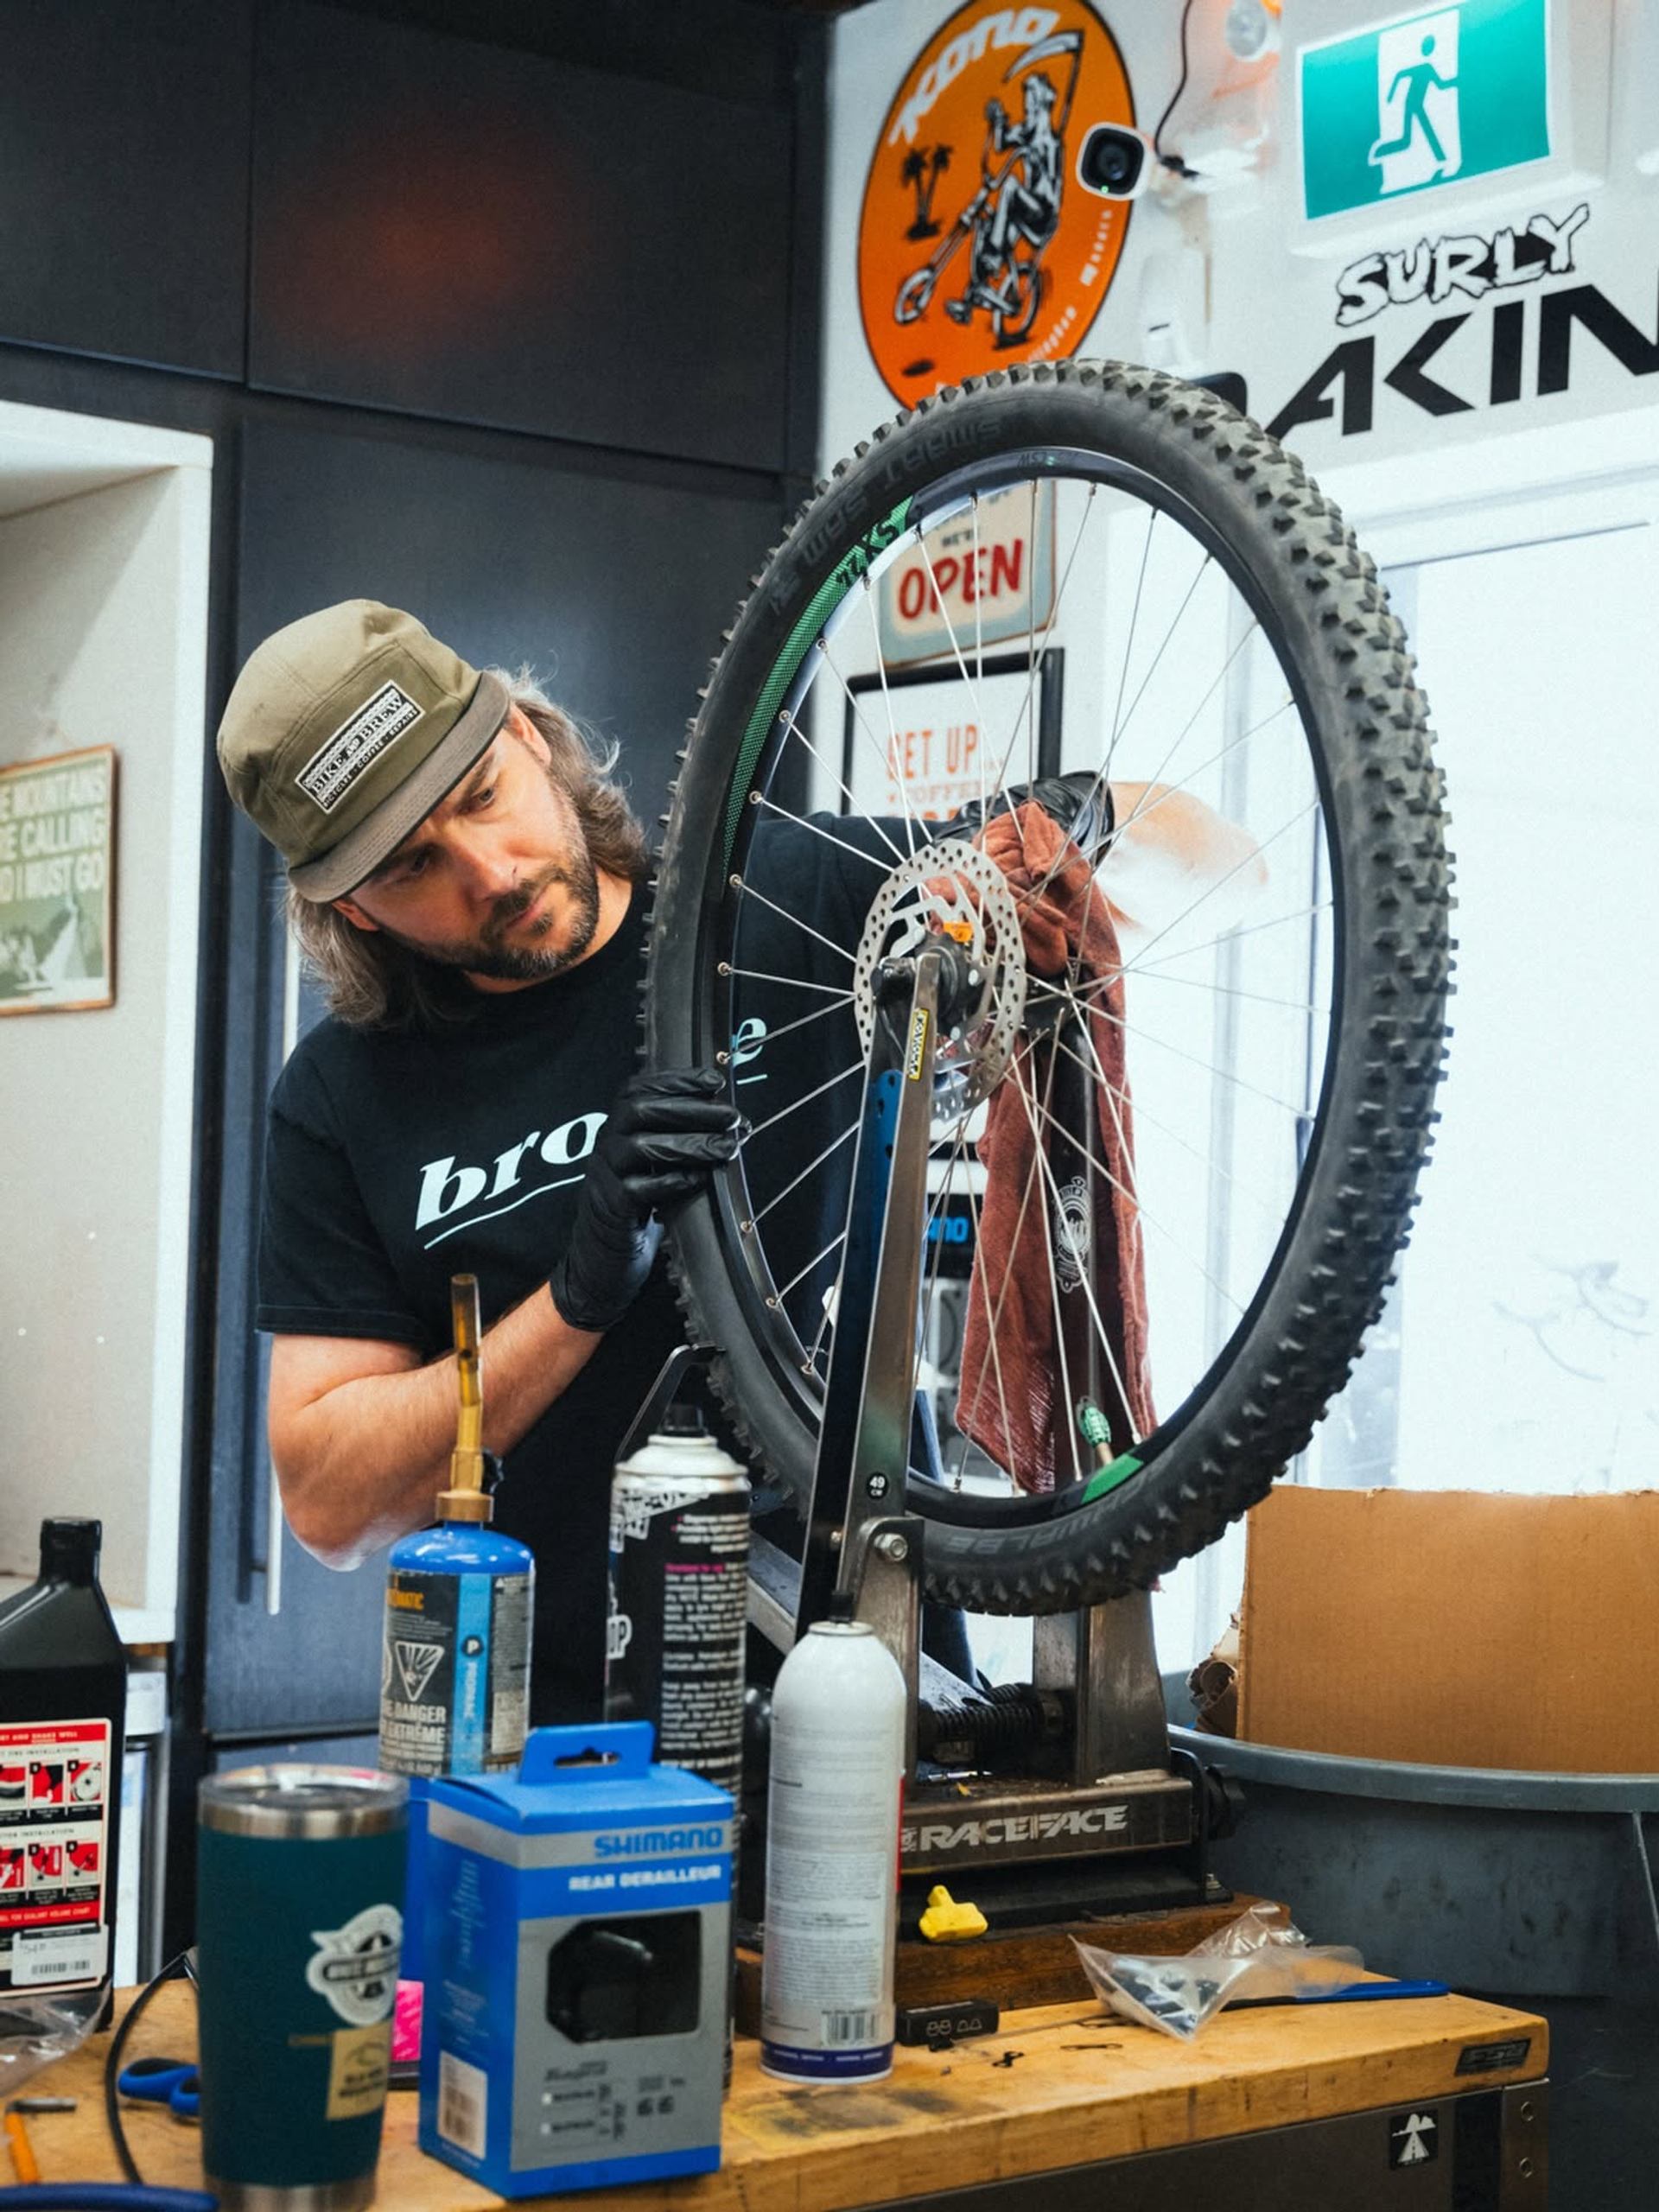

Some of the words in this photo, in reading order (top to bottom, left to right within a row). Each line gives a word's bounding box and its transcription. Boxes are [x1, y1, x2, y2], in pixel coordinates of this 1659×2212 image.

[1334, 203, 1590, 328] SURLY
[898, 537, 1023, 620] OPEN
[312, 754, 346, 793] BIKE
[360, 698, 404, 740] BREW
[20, 808, 105, 857] CALLING
[74, 852, 104, 892] GO
[869, 1476, 886, 1489] 49
[395, 1701, 447, 1724] DANGER
[594, 1825, 724, 1858] SHIMANO
[569, 1872, 615, 1891] REAR
[619, 1865, 721, 1887] DERAILLEUR
